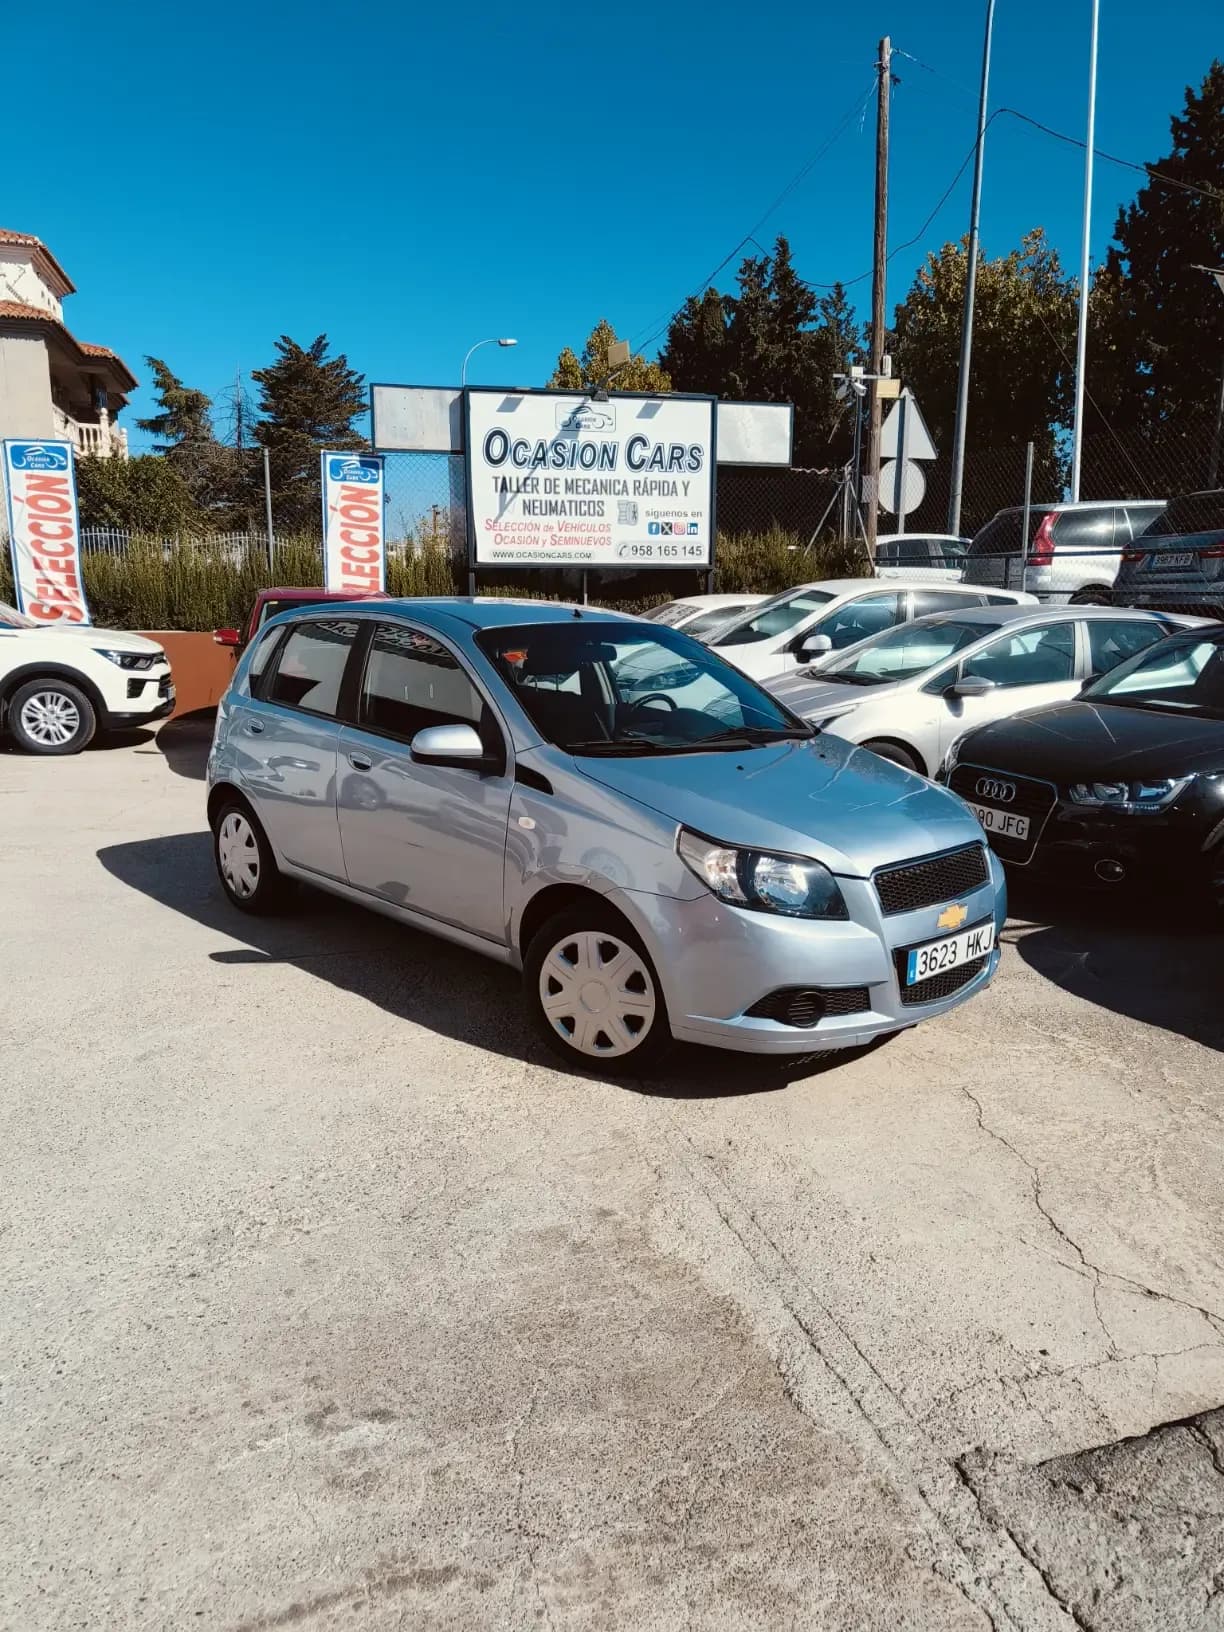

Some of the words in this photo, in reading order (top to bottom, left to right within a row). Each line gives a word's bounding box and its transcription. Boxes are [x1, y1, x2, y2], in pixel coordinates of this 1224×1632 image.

[483, 427, 619, 471] OCASION
[625, 433, 704, 473] CARS
[492, 476, 539, 494] TALLER
[544, 478, 560, 495] DE
[565, 478, 629, 496] MECANICA
[633, 477, 678, 497] RÁPIDA
[682, 480, 690, 497] Y
[522, 499, 605, 517] NEUMATICOS
[543, 523, 554, 532] de
[330, 484, 380, 593] LECCIÓN
[540, 538, 548, 547] y
[550, 534, 612, 546] SEMINUEVOS
[631, 546, 653, 556] 958
[657, 546, 678, 556] 165
[682, 546, 702, 556] 145
[998, 815, 1025, 836] JFG
[918, 940, 958, 976] 3623
[966, 927, 993, 959] HKJ
